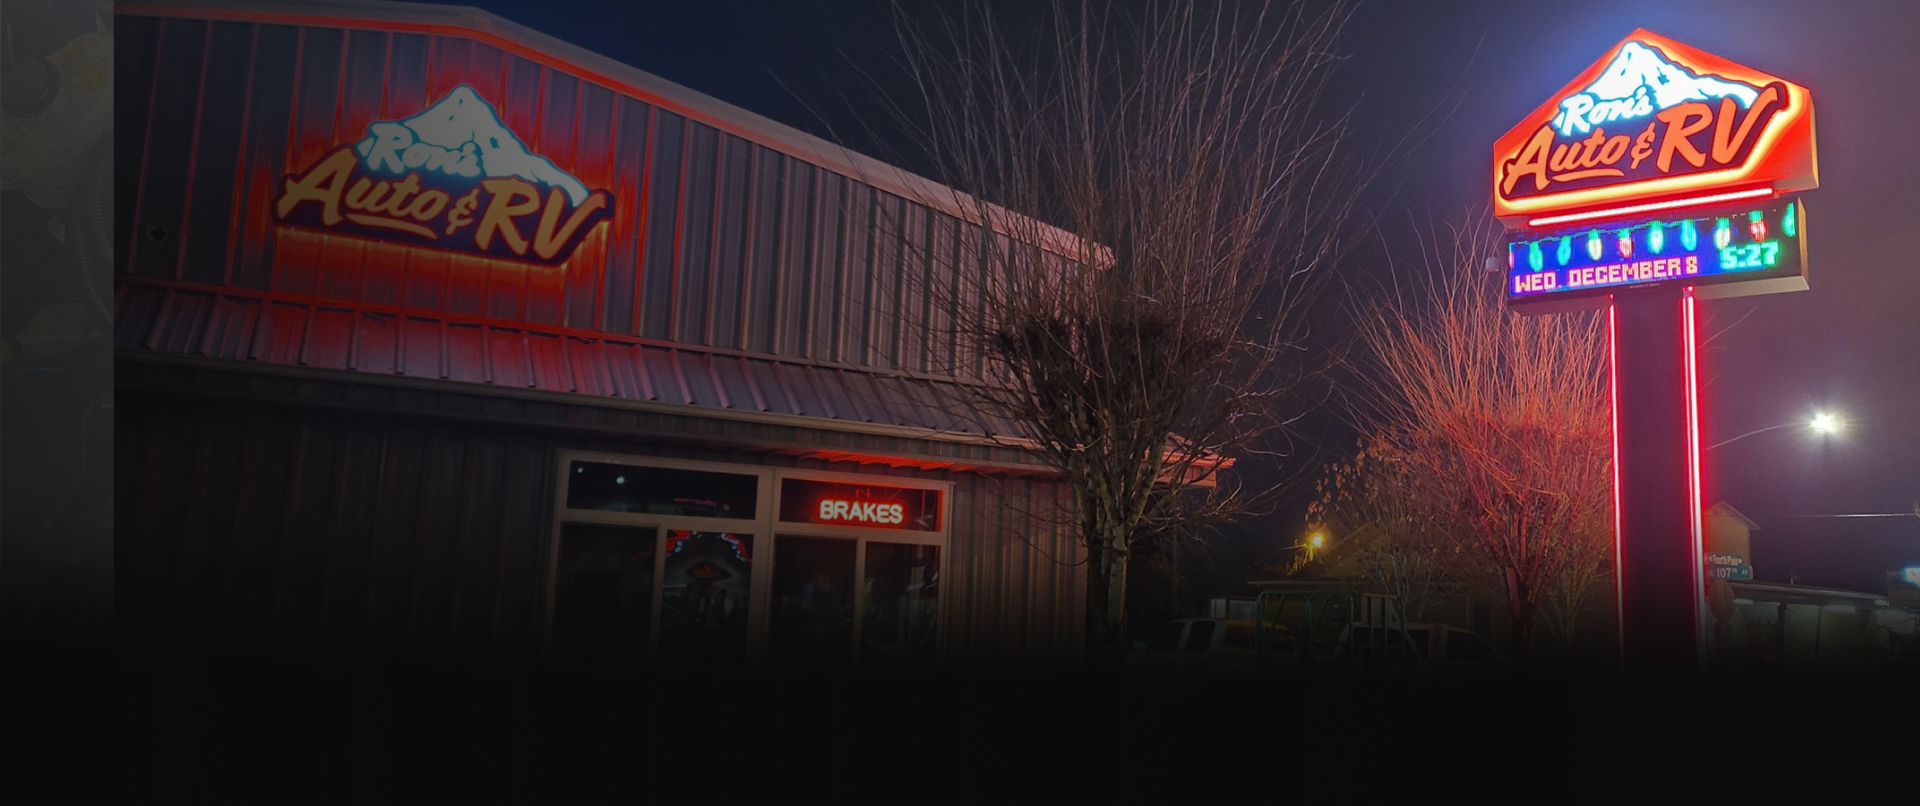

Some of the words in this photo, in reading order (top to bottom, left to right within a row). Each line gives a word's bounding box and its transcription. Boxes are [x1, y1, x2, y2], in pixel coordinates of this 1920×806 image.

[1552, 86, 1653, 136] Ron's
[356, 122, 481, 178] Ron's
[1504, 125, 1631, 195] Auto
[1630, 122, 1656, 170] &
[1655, 87, 1778, 174] RV
[276, 147, 450, 227] Auto
[445, 188, 480, 236] &
[474, 177, 605, 260] RV
[1568, 258, 1682, 287] DECEMBER
[1685, 255, 1698, 274] 8
[1720, 241, 1779, 270] 5:27
[818, 499, 904, 525] BRAKES
